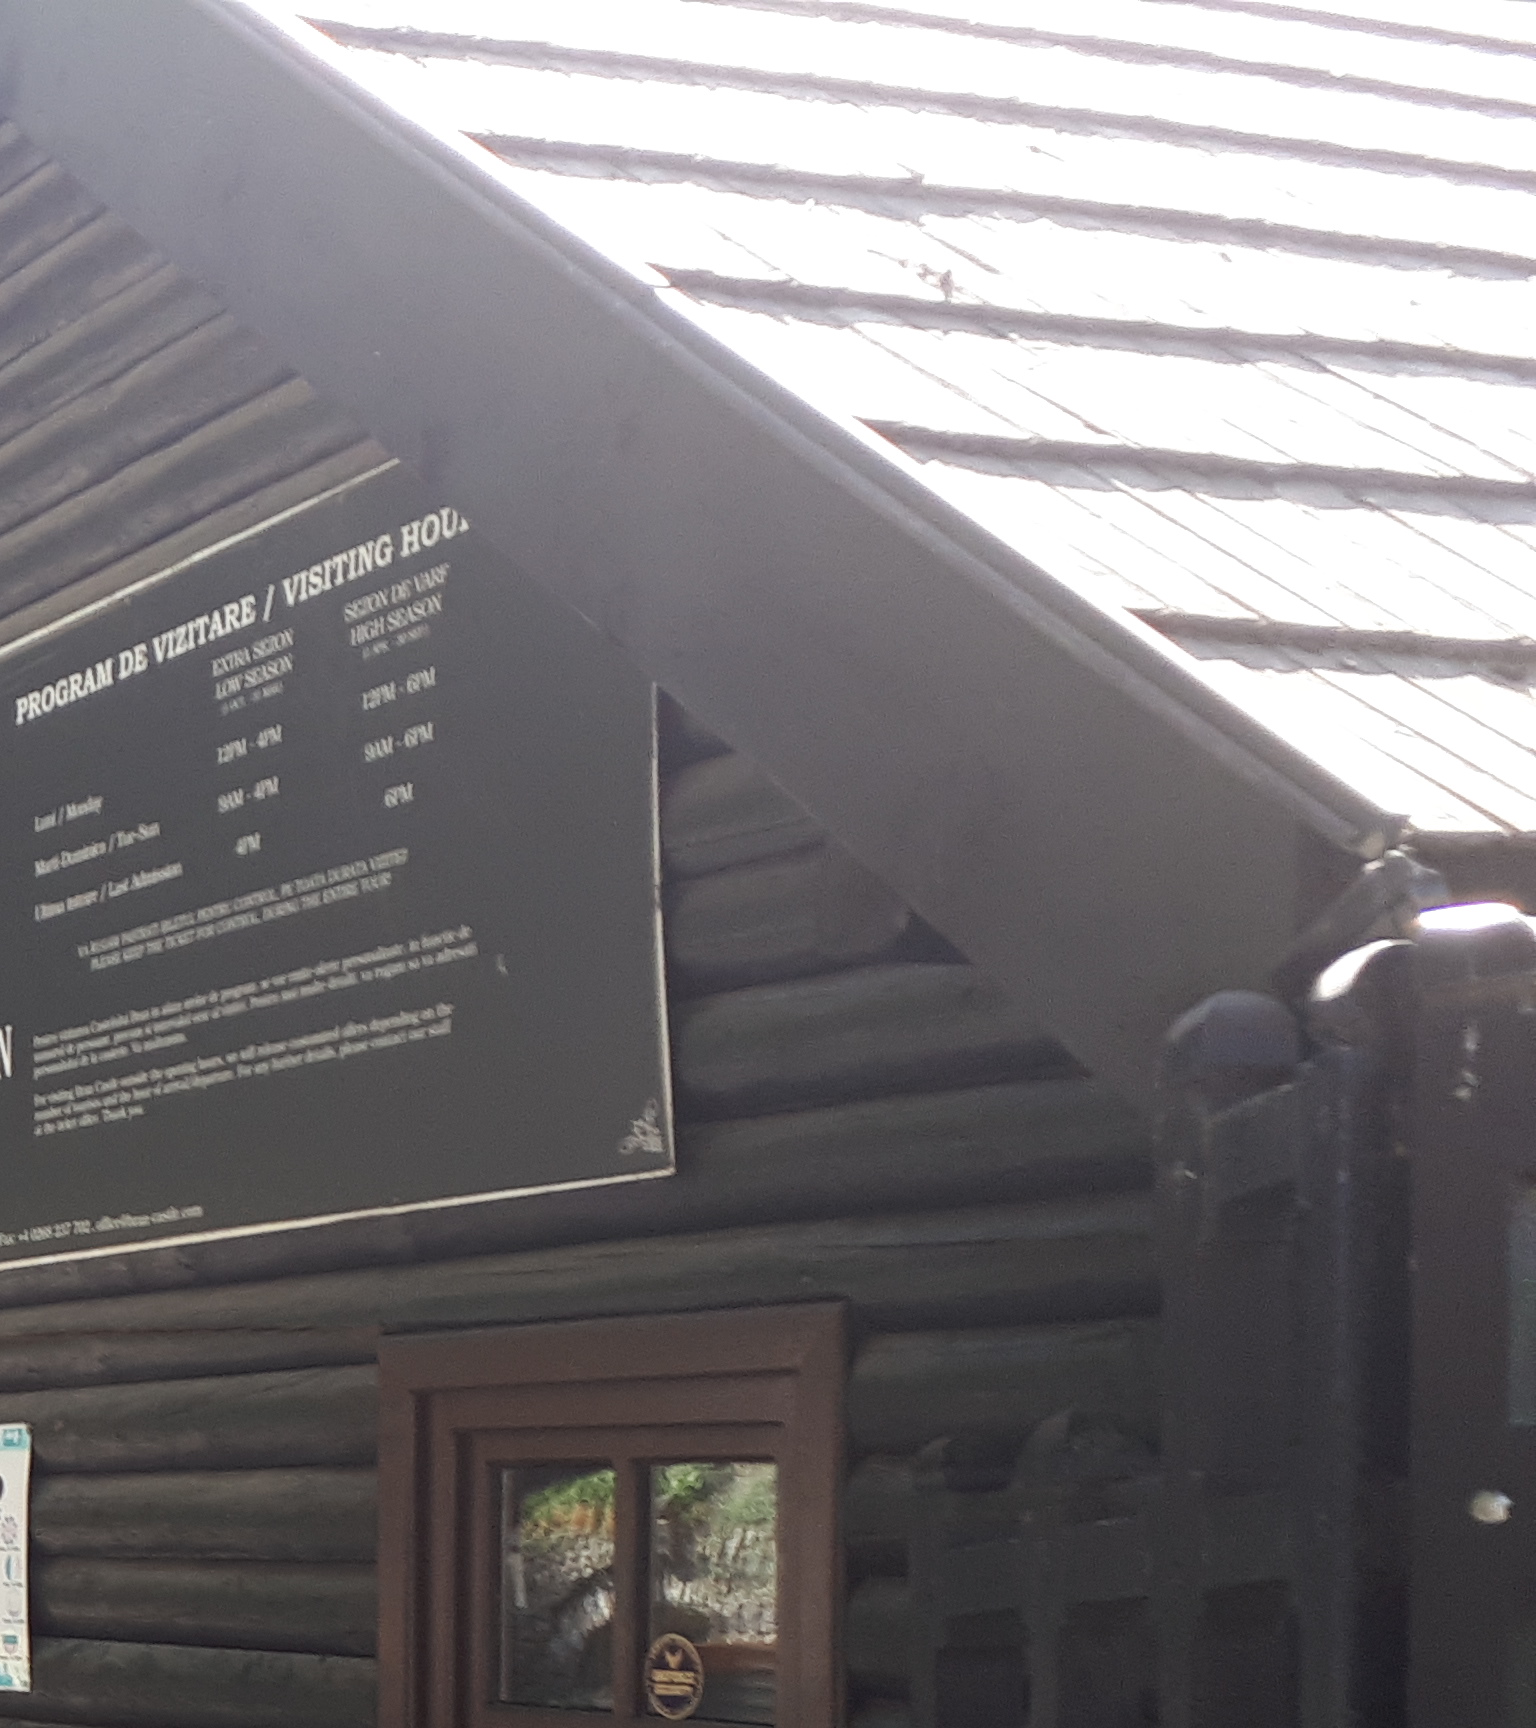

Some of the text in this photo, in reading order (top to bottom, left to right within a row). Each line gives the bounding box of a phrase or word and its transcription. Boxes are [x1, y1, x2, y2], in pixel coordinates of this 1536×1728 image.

[15, 656, 115, 726] PROGRAM
[117, 643, 149, 681] DE
[151, 594, 258, 665] VIZITARE
[281, 533, 393, 607] VISITING
[399, 505, 470, 556] HOU
[386, 592, 443, 632] SEASON
[244, 652, 294, 689] SEASON
